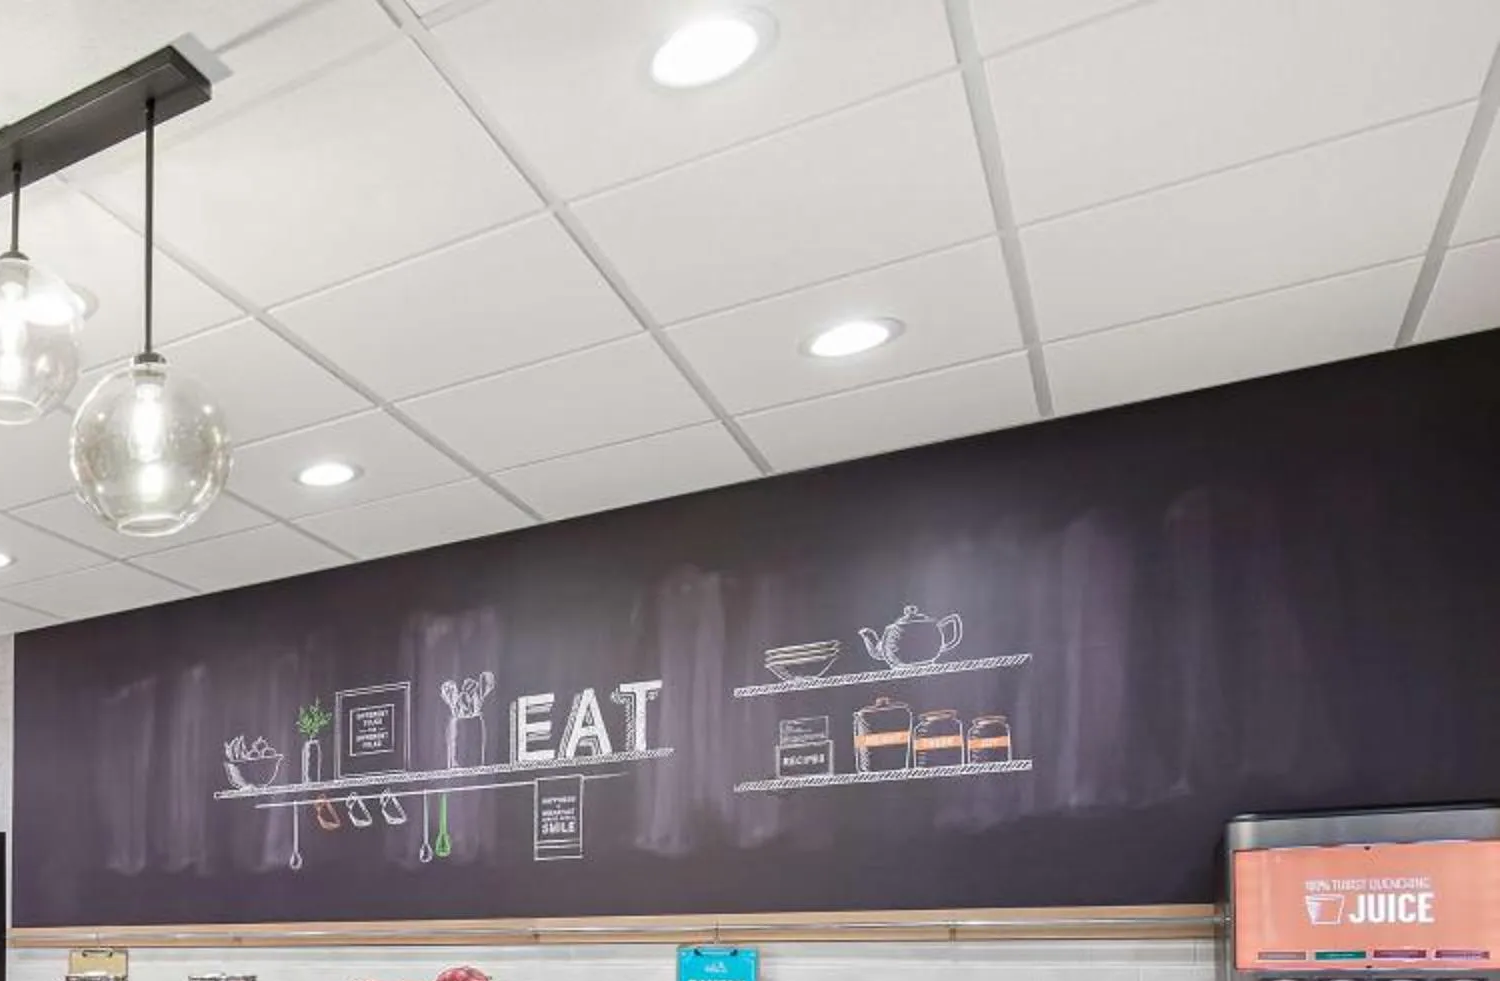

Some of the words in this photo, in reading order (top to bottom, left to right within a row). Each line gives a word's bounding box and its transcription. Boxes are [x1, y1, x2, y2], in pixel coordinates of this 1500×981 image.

[510, 680, 662, 766] EAT
[541, 821, 577, 835] SMILE
[1348, 892, 1436, 924] JUICE
